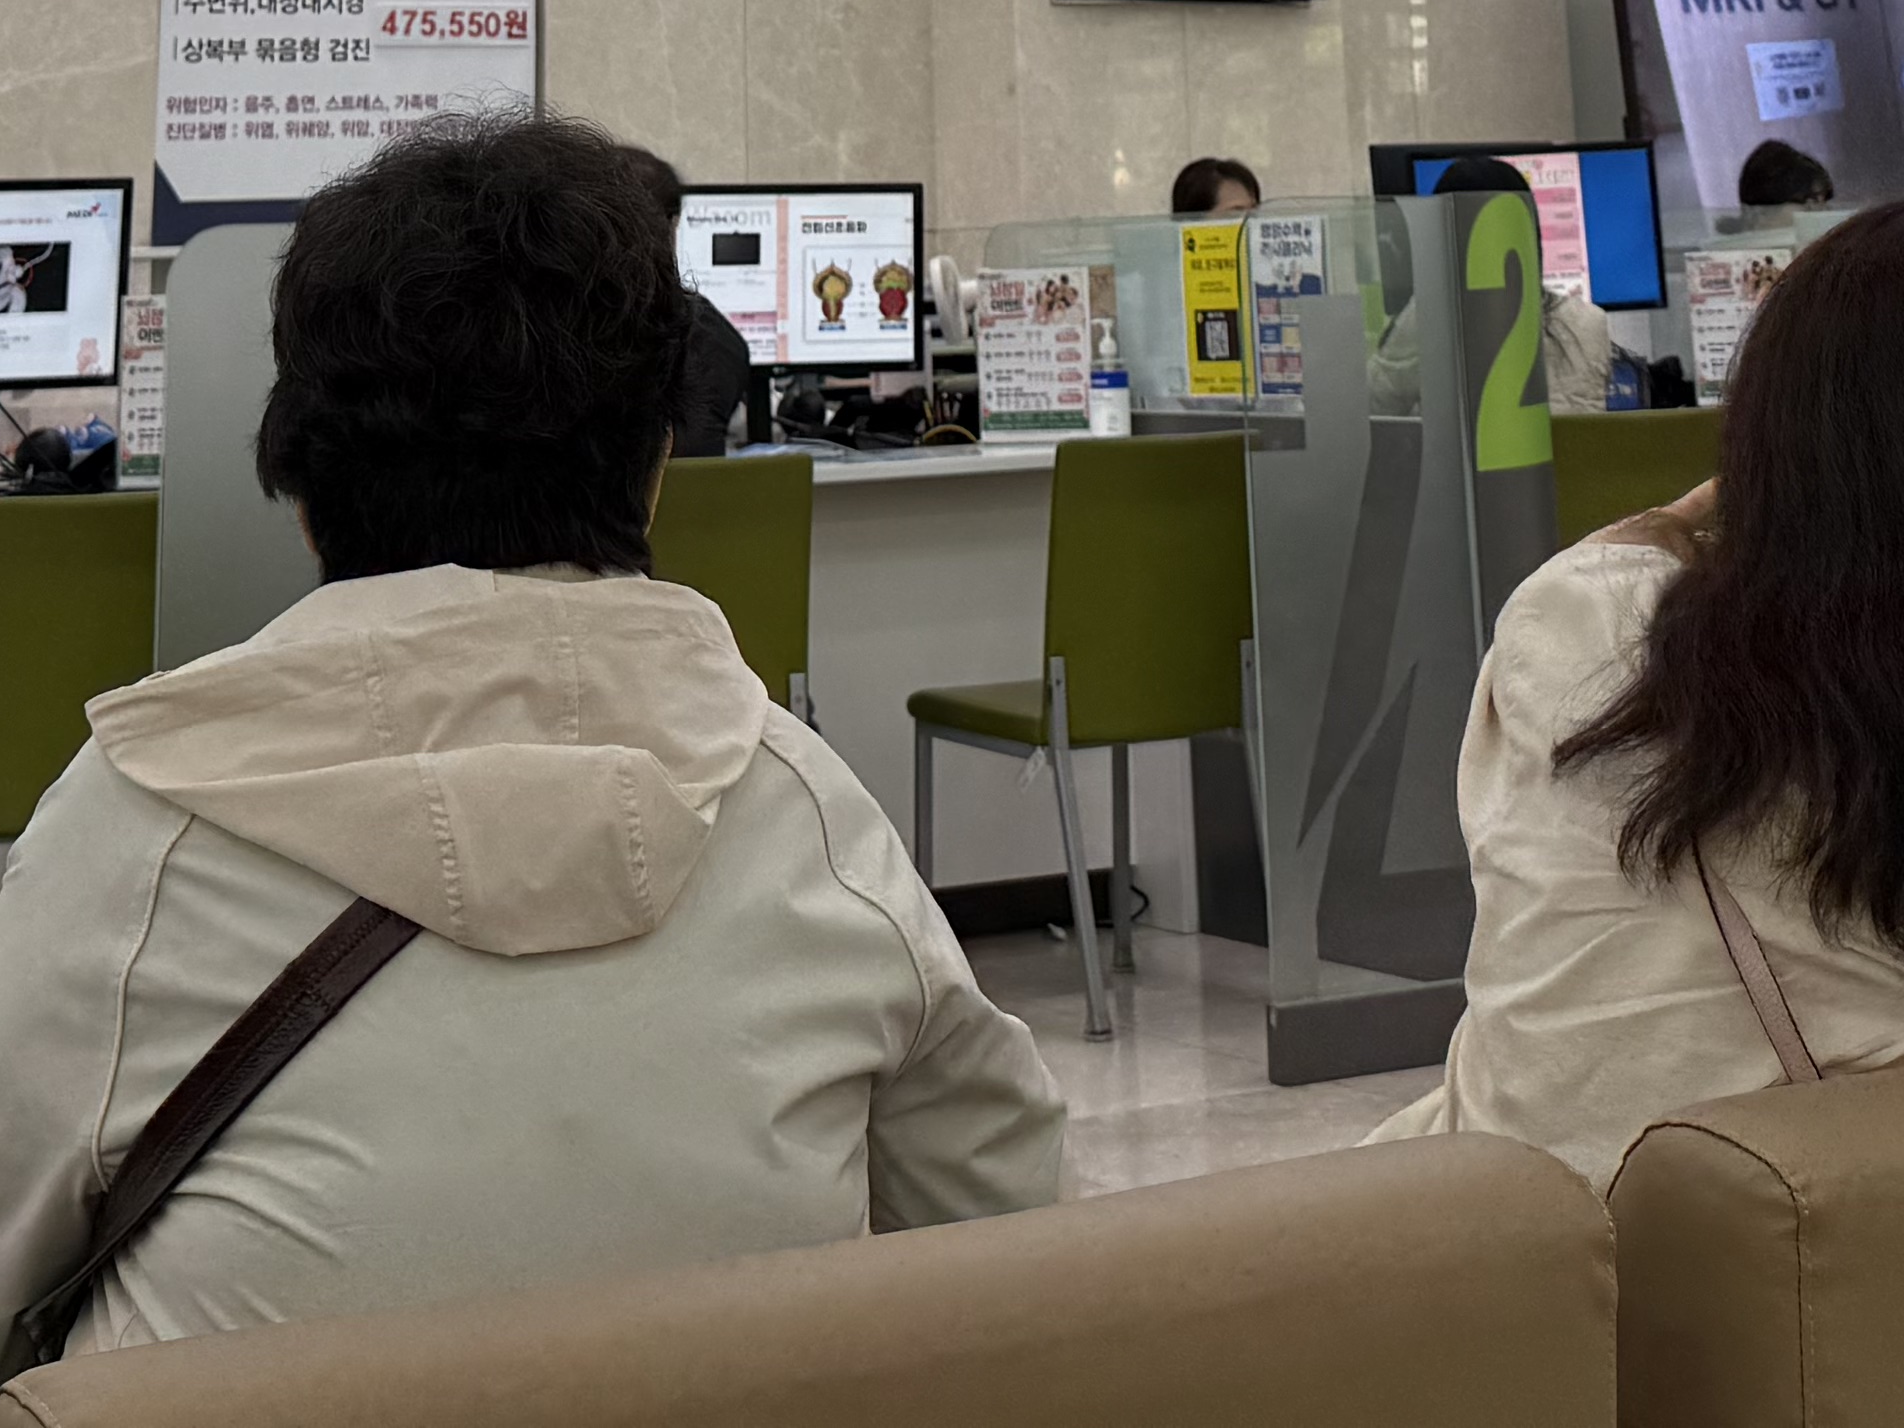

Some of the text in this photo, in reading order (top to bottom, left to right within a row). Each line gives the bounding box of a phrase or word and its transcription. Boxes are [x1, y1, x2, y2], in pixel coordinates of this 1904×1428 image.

[381, 9, 528, 41] 475,550원
[182, 37, 371, 63] 상복부 묶음형 검진
[1466, 193, 1553, 472] 2
